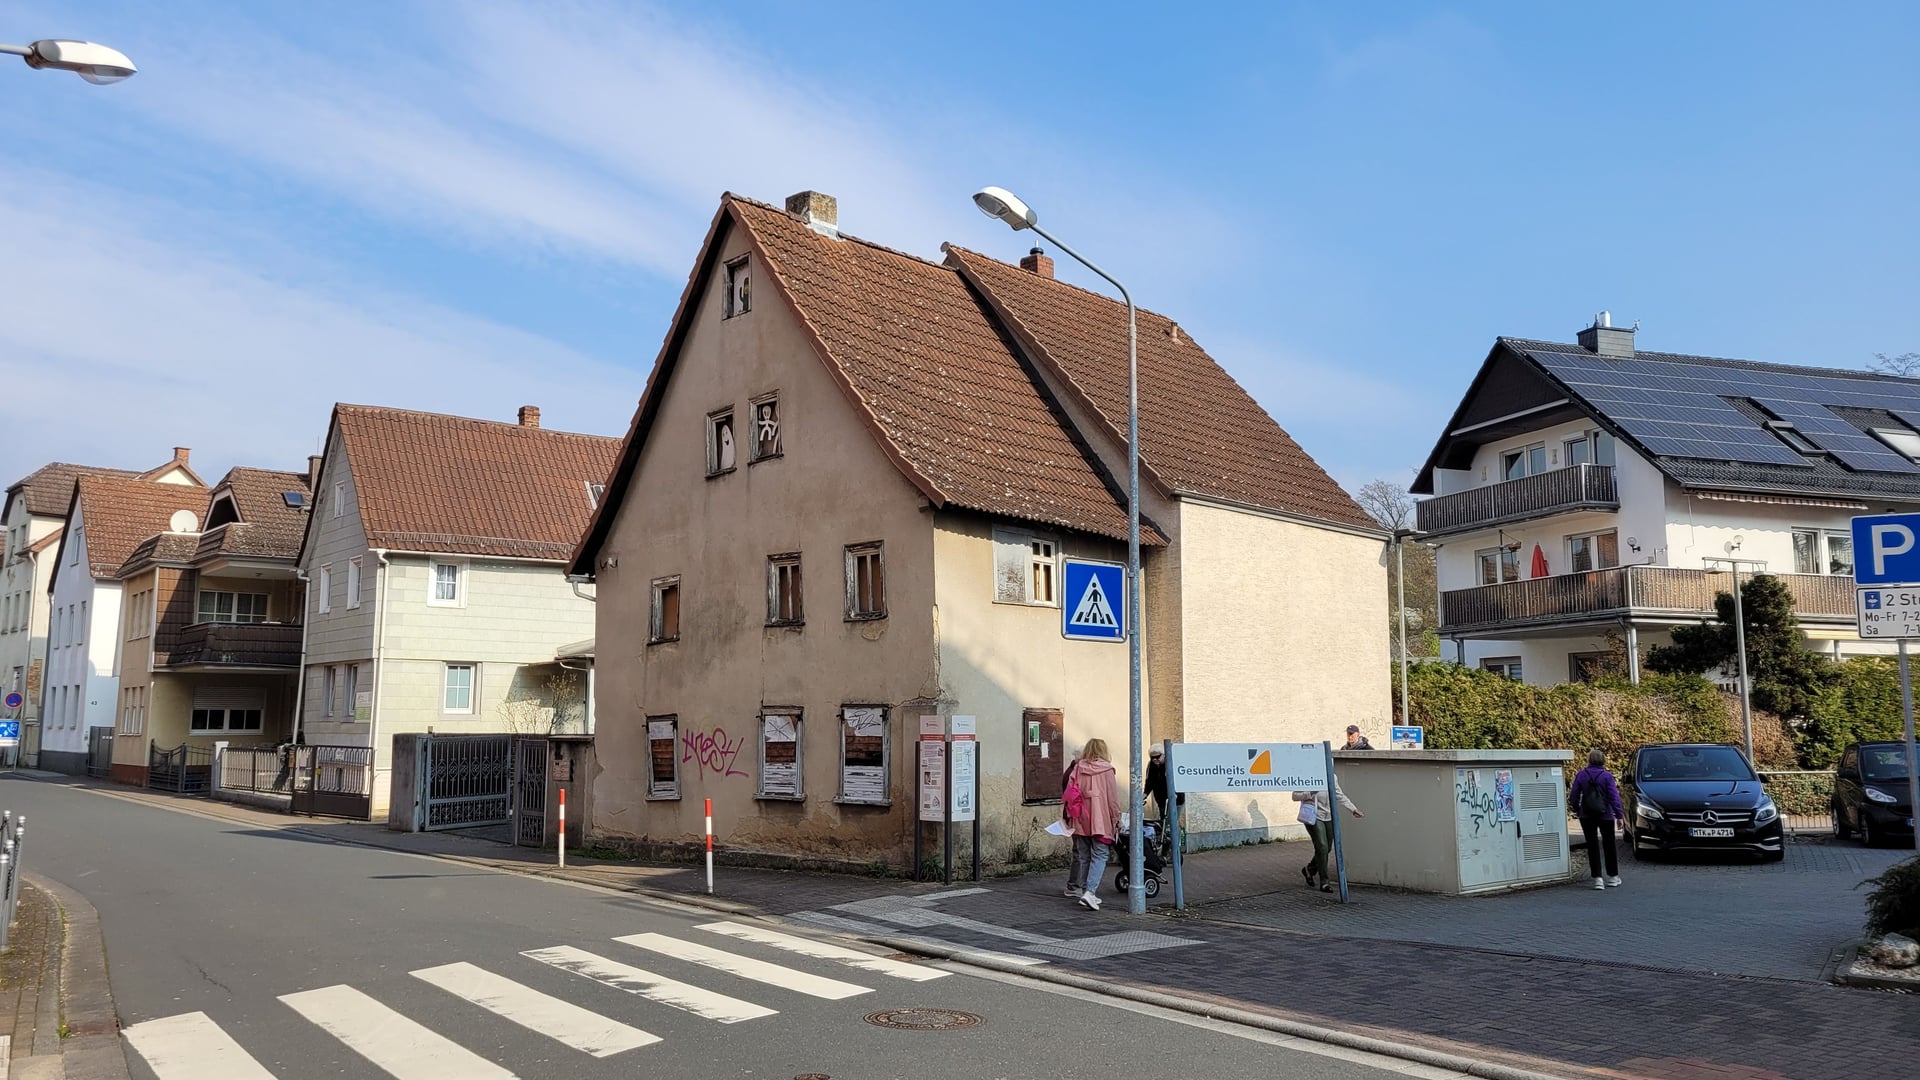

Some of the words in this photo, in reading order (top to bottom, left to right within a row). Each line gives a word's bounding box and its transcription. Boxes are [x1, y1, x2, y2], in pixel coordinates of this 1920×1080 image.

[1871, 524, 1915, 576] P
[1886, 594, 1895, 606] 2
[1900, 593, 1920, 606] St
[1865, 611, 1897, 622] Mo-Fr
[1866, 625, 1879, 635] Sa
[1177, 765, 1245, 776] Gesundheits
[1227, 777, 1324, 787] ZentrumKelkheim
